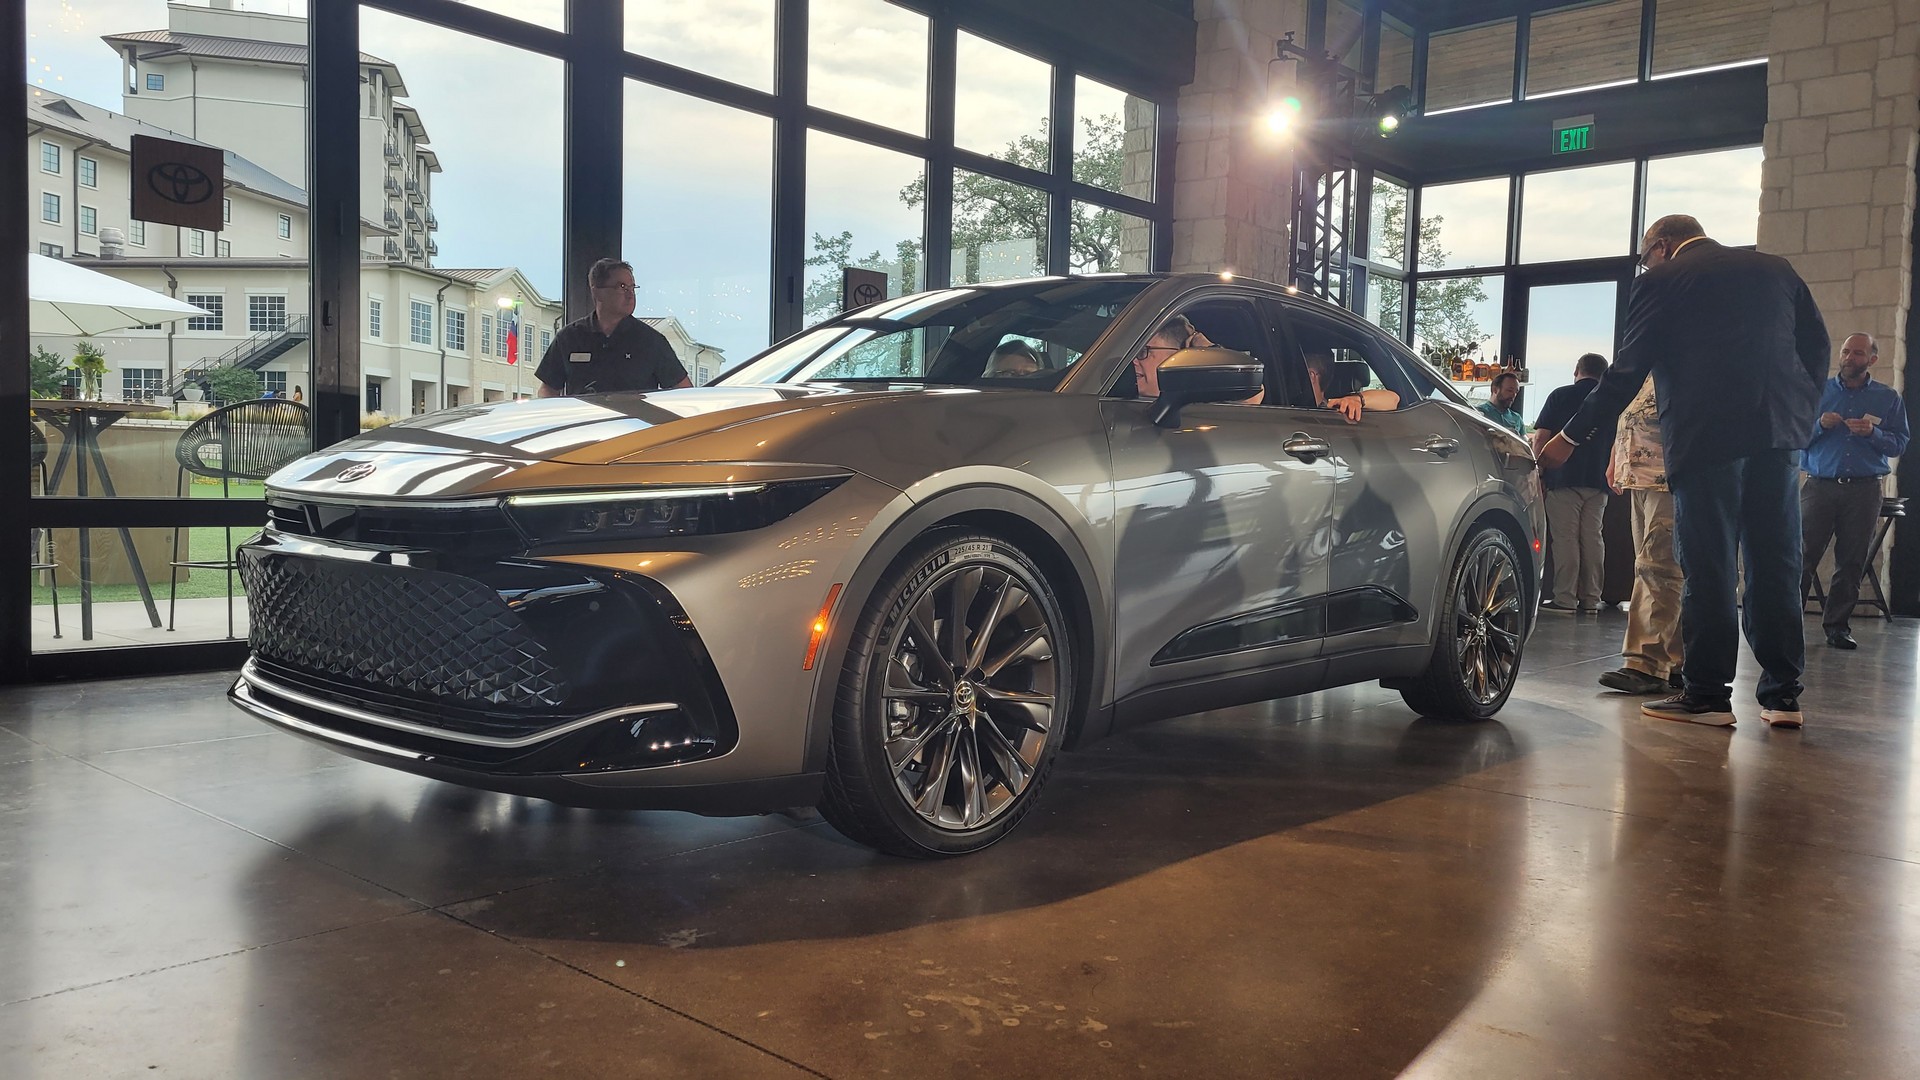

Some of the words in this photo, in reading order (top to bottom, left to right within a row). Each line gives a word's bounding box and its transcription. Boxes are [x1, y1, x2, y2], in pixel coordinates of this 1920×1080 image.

[1560, 126, 1589, 152] EXIT
[954, 544, 975, 555] 225/45
[889, 553, 946, 622] MICHELIN
